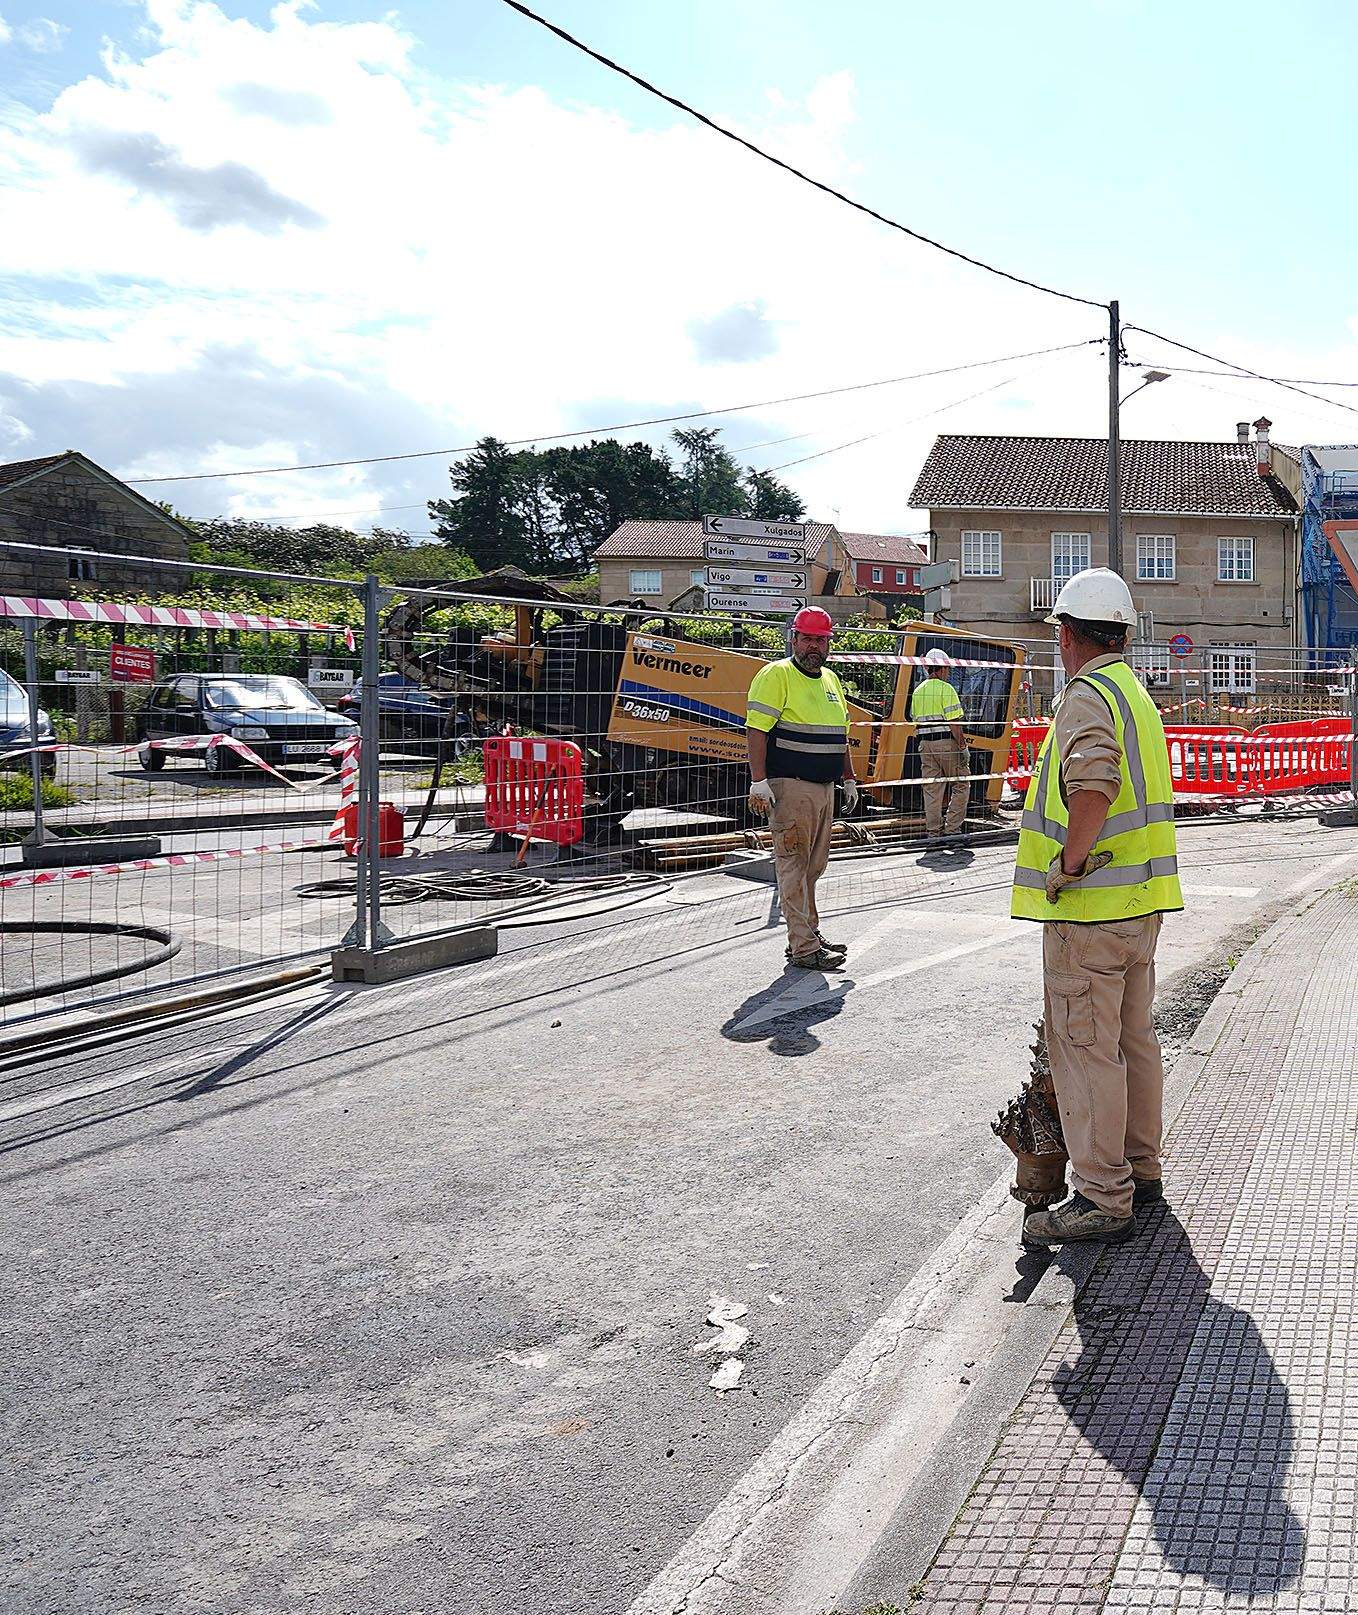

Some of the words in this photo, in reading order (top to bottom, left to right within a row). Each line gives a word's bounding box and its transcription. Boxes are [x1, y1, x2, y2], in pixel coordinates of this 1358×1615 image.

[764, 525, 802, 537] Xulgados
[710, 571, 731, 581] Vigo
[711, 597, 748, 606] Ourense
[115, 656, 152, 669] CLIENTES
[632, 647, 713, 679] Vermeer
[623, 701, 670, 722] D36x50
